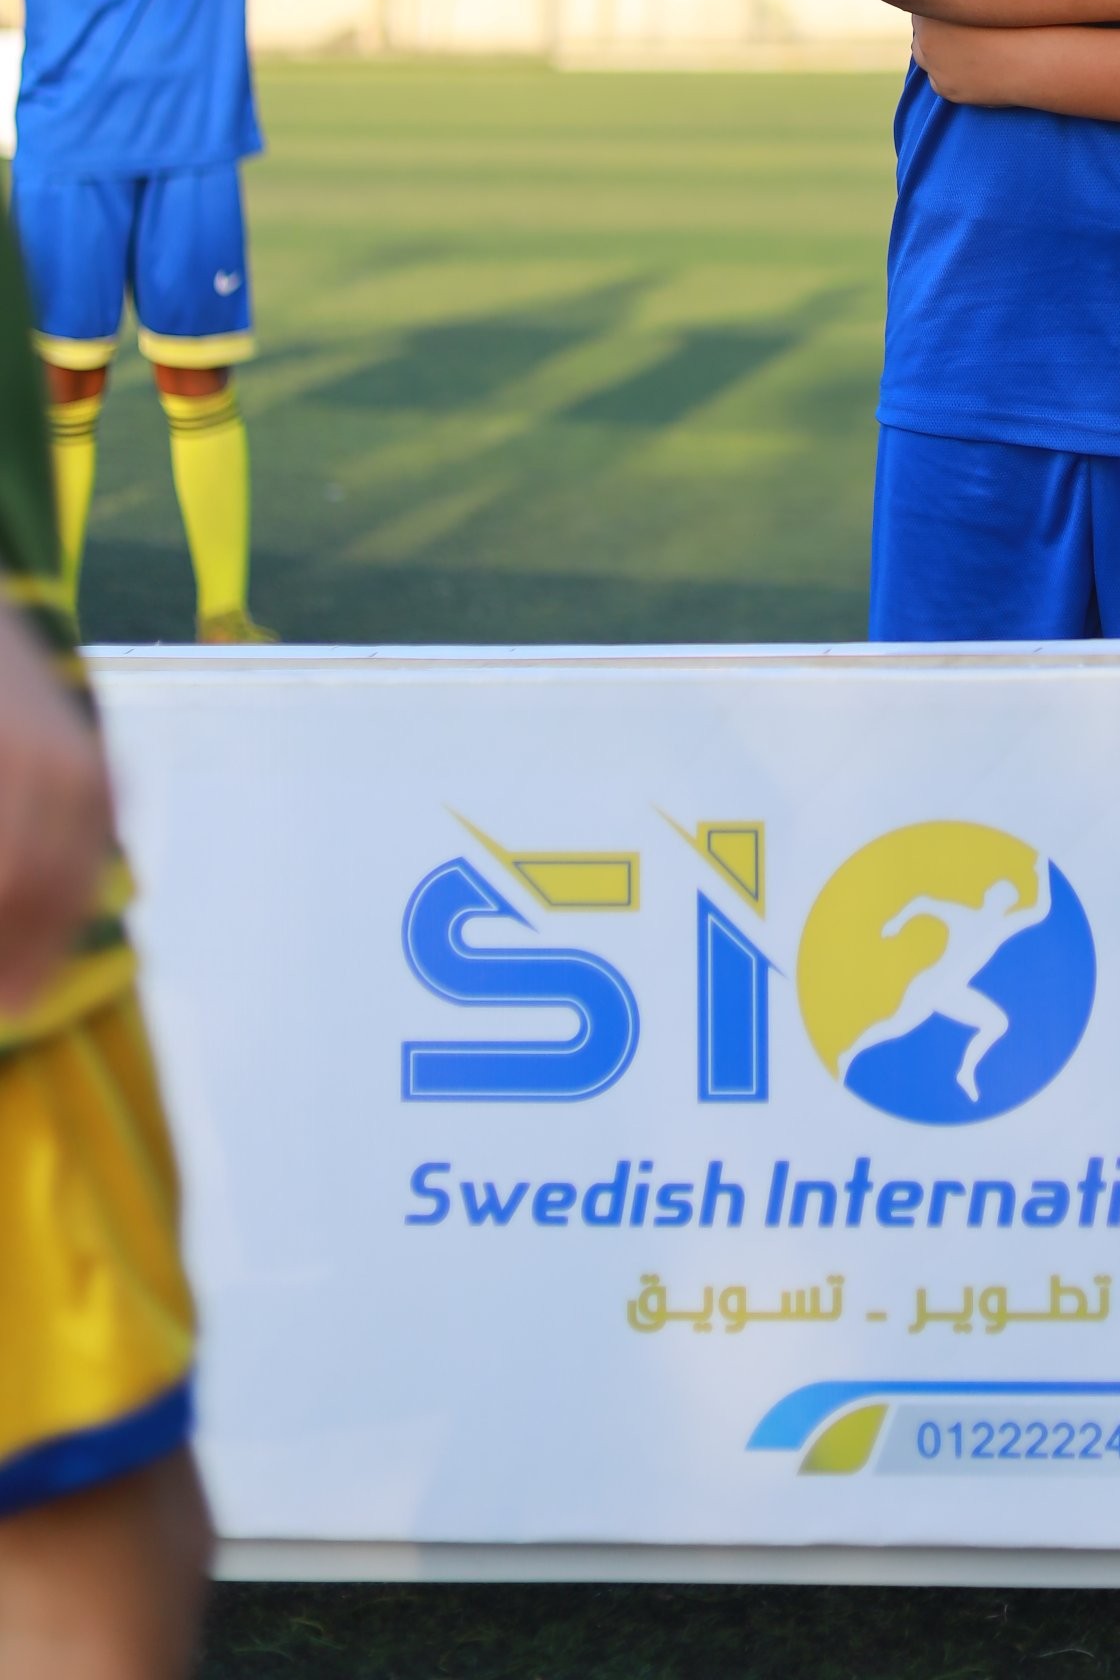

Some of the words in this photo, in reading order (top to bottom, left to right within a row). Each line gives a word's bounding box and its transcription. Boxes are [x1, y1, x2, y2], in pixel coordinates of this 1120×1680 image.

[405, 1160, 747, 1229] Swedish
[627, 1273, 845, 1334] تسويق
[908, 1274, 1112, 1334] تطوير
